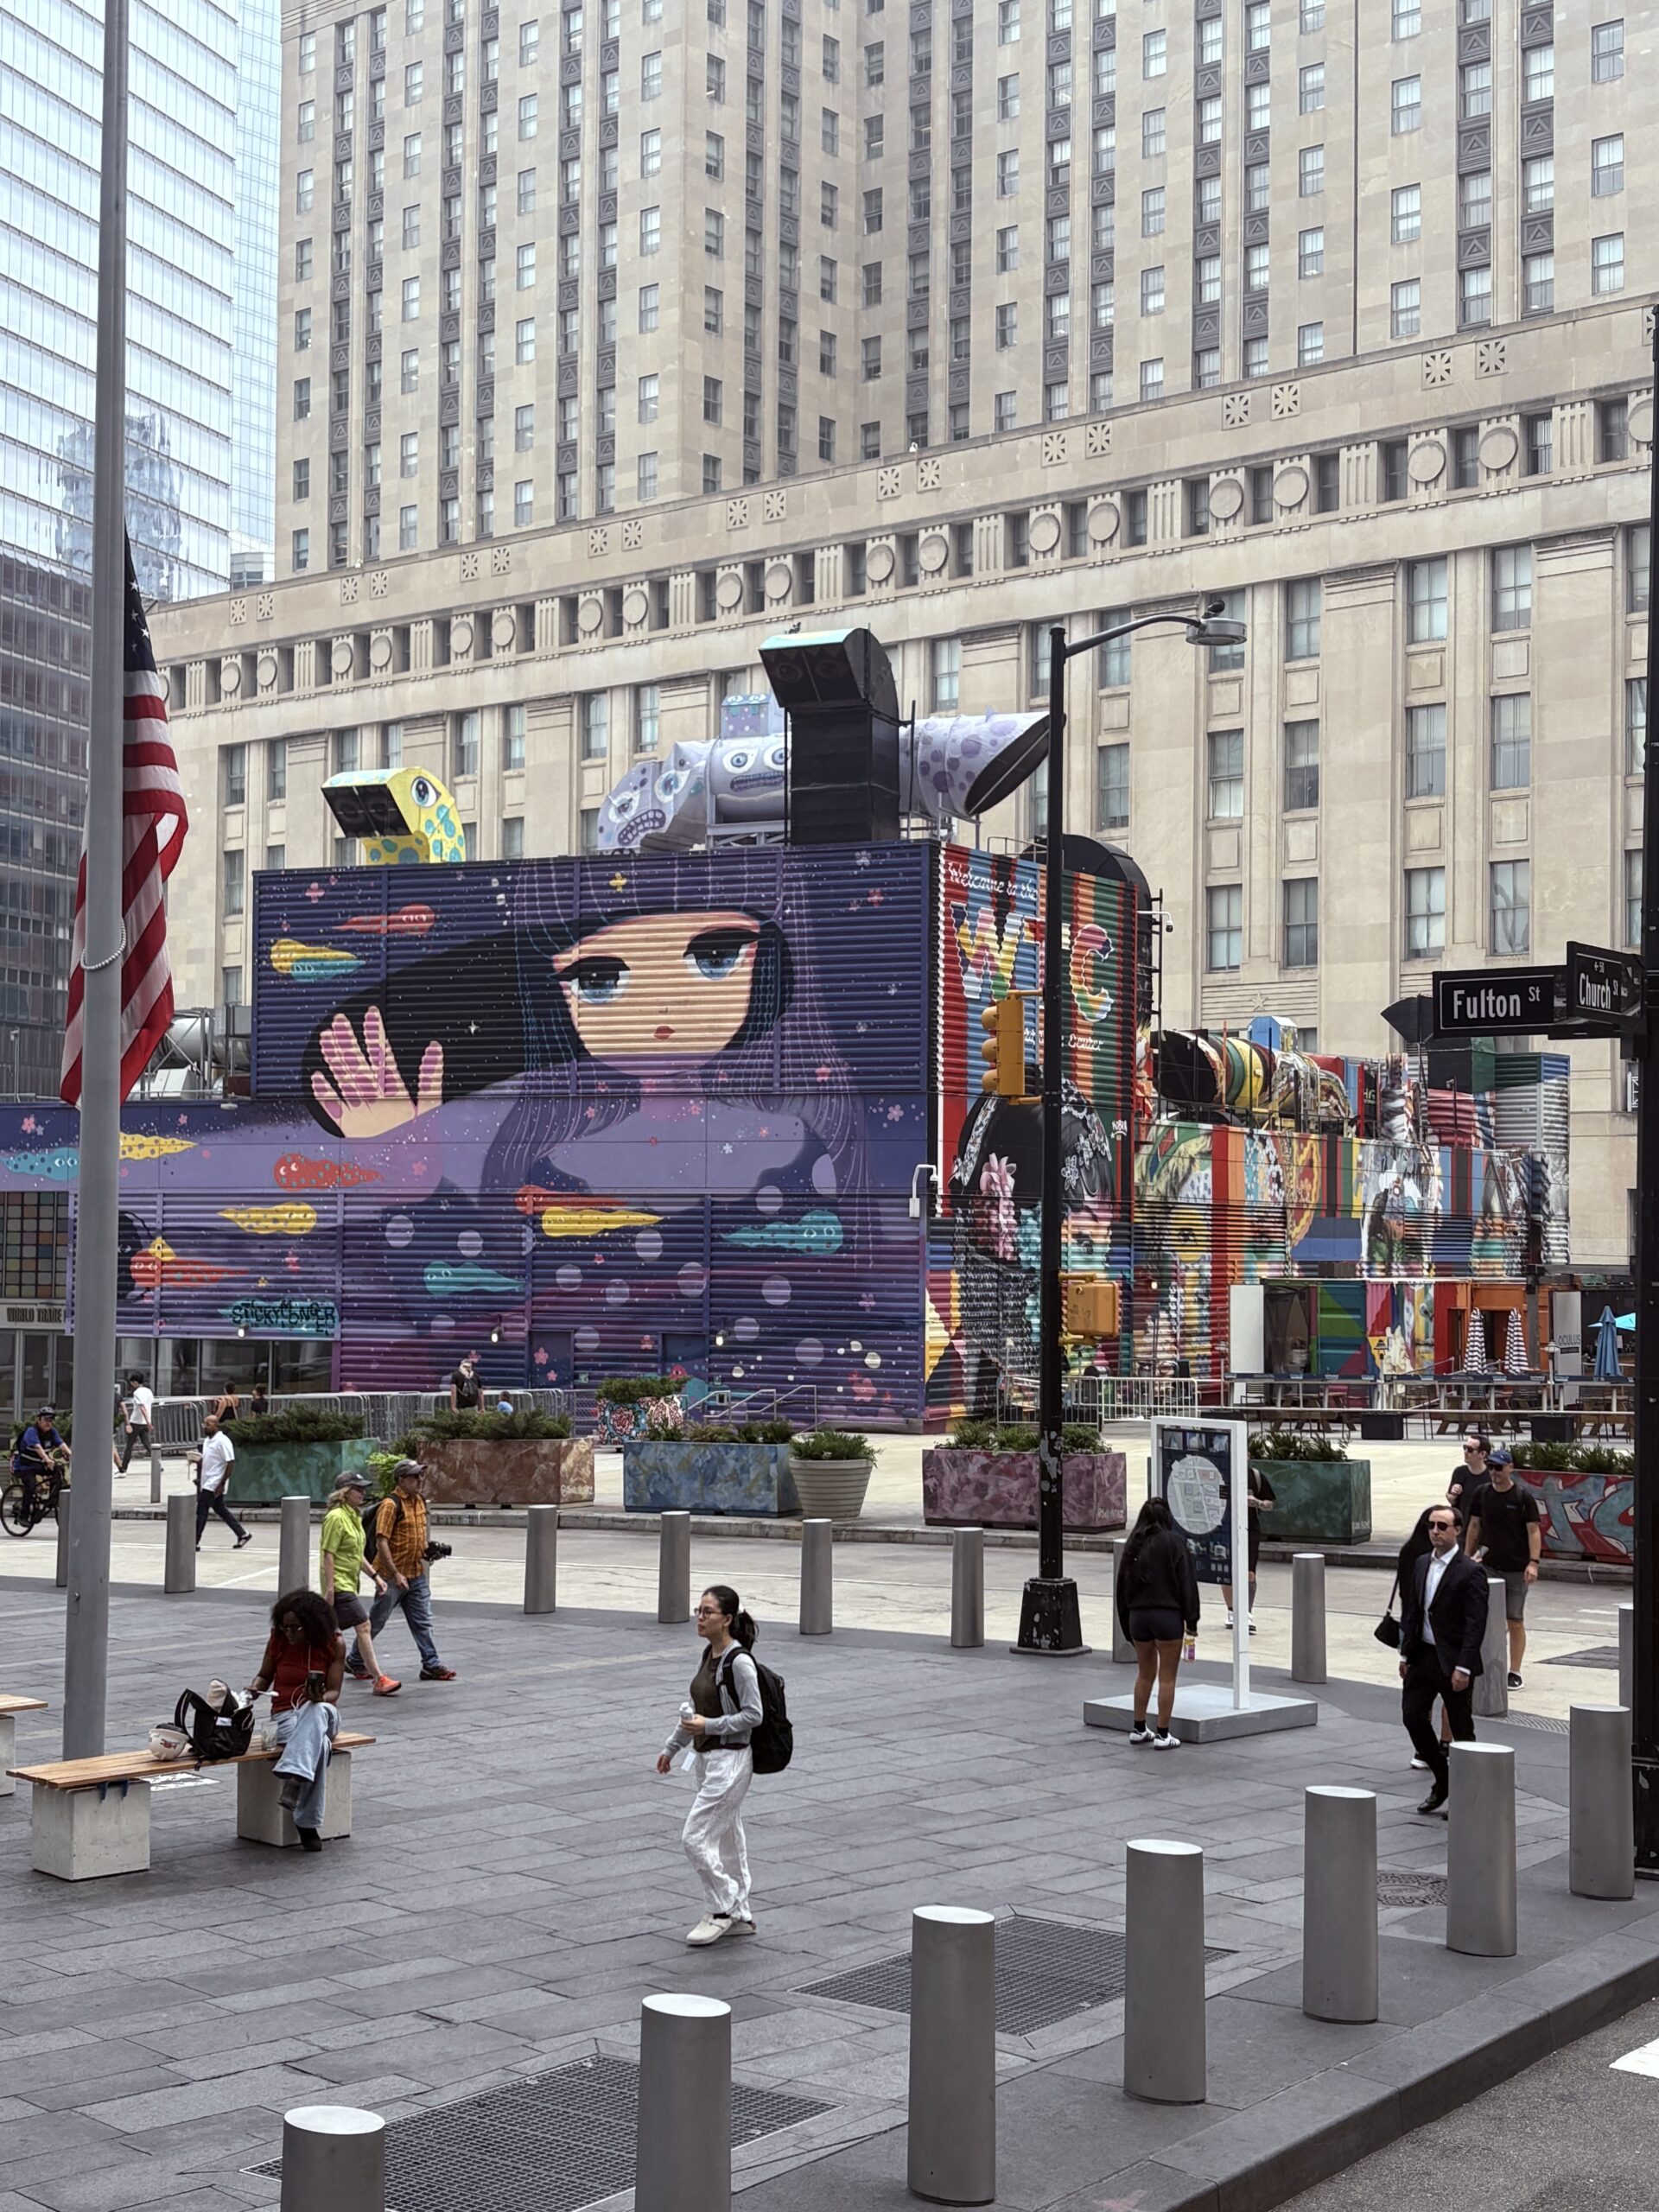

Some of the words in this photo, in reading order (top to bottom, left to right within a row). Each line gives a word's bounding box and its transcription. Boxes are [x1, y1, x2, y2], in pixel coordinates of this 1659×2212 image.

[949, 862, 1005, 893] Welcome
[1007, 880, 1018, 896] to
[1452, 988, 1522, 1020] Fulton
[1528, 986, 1541, 1002] St
[1579, 972, 1611, 1010] Church
[1612, 979, 1619, 996] St
[6, 1307, 35, 1323] WORLD
[35, 1307, 63, 1324] TRADE
